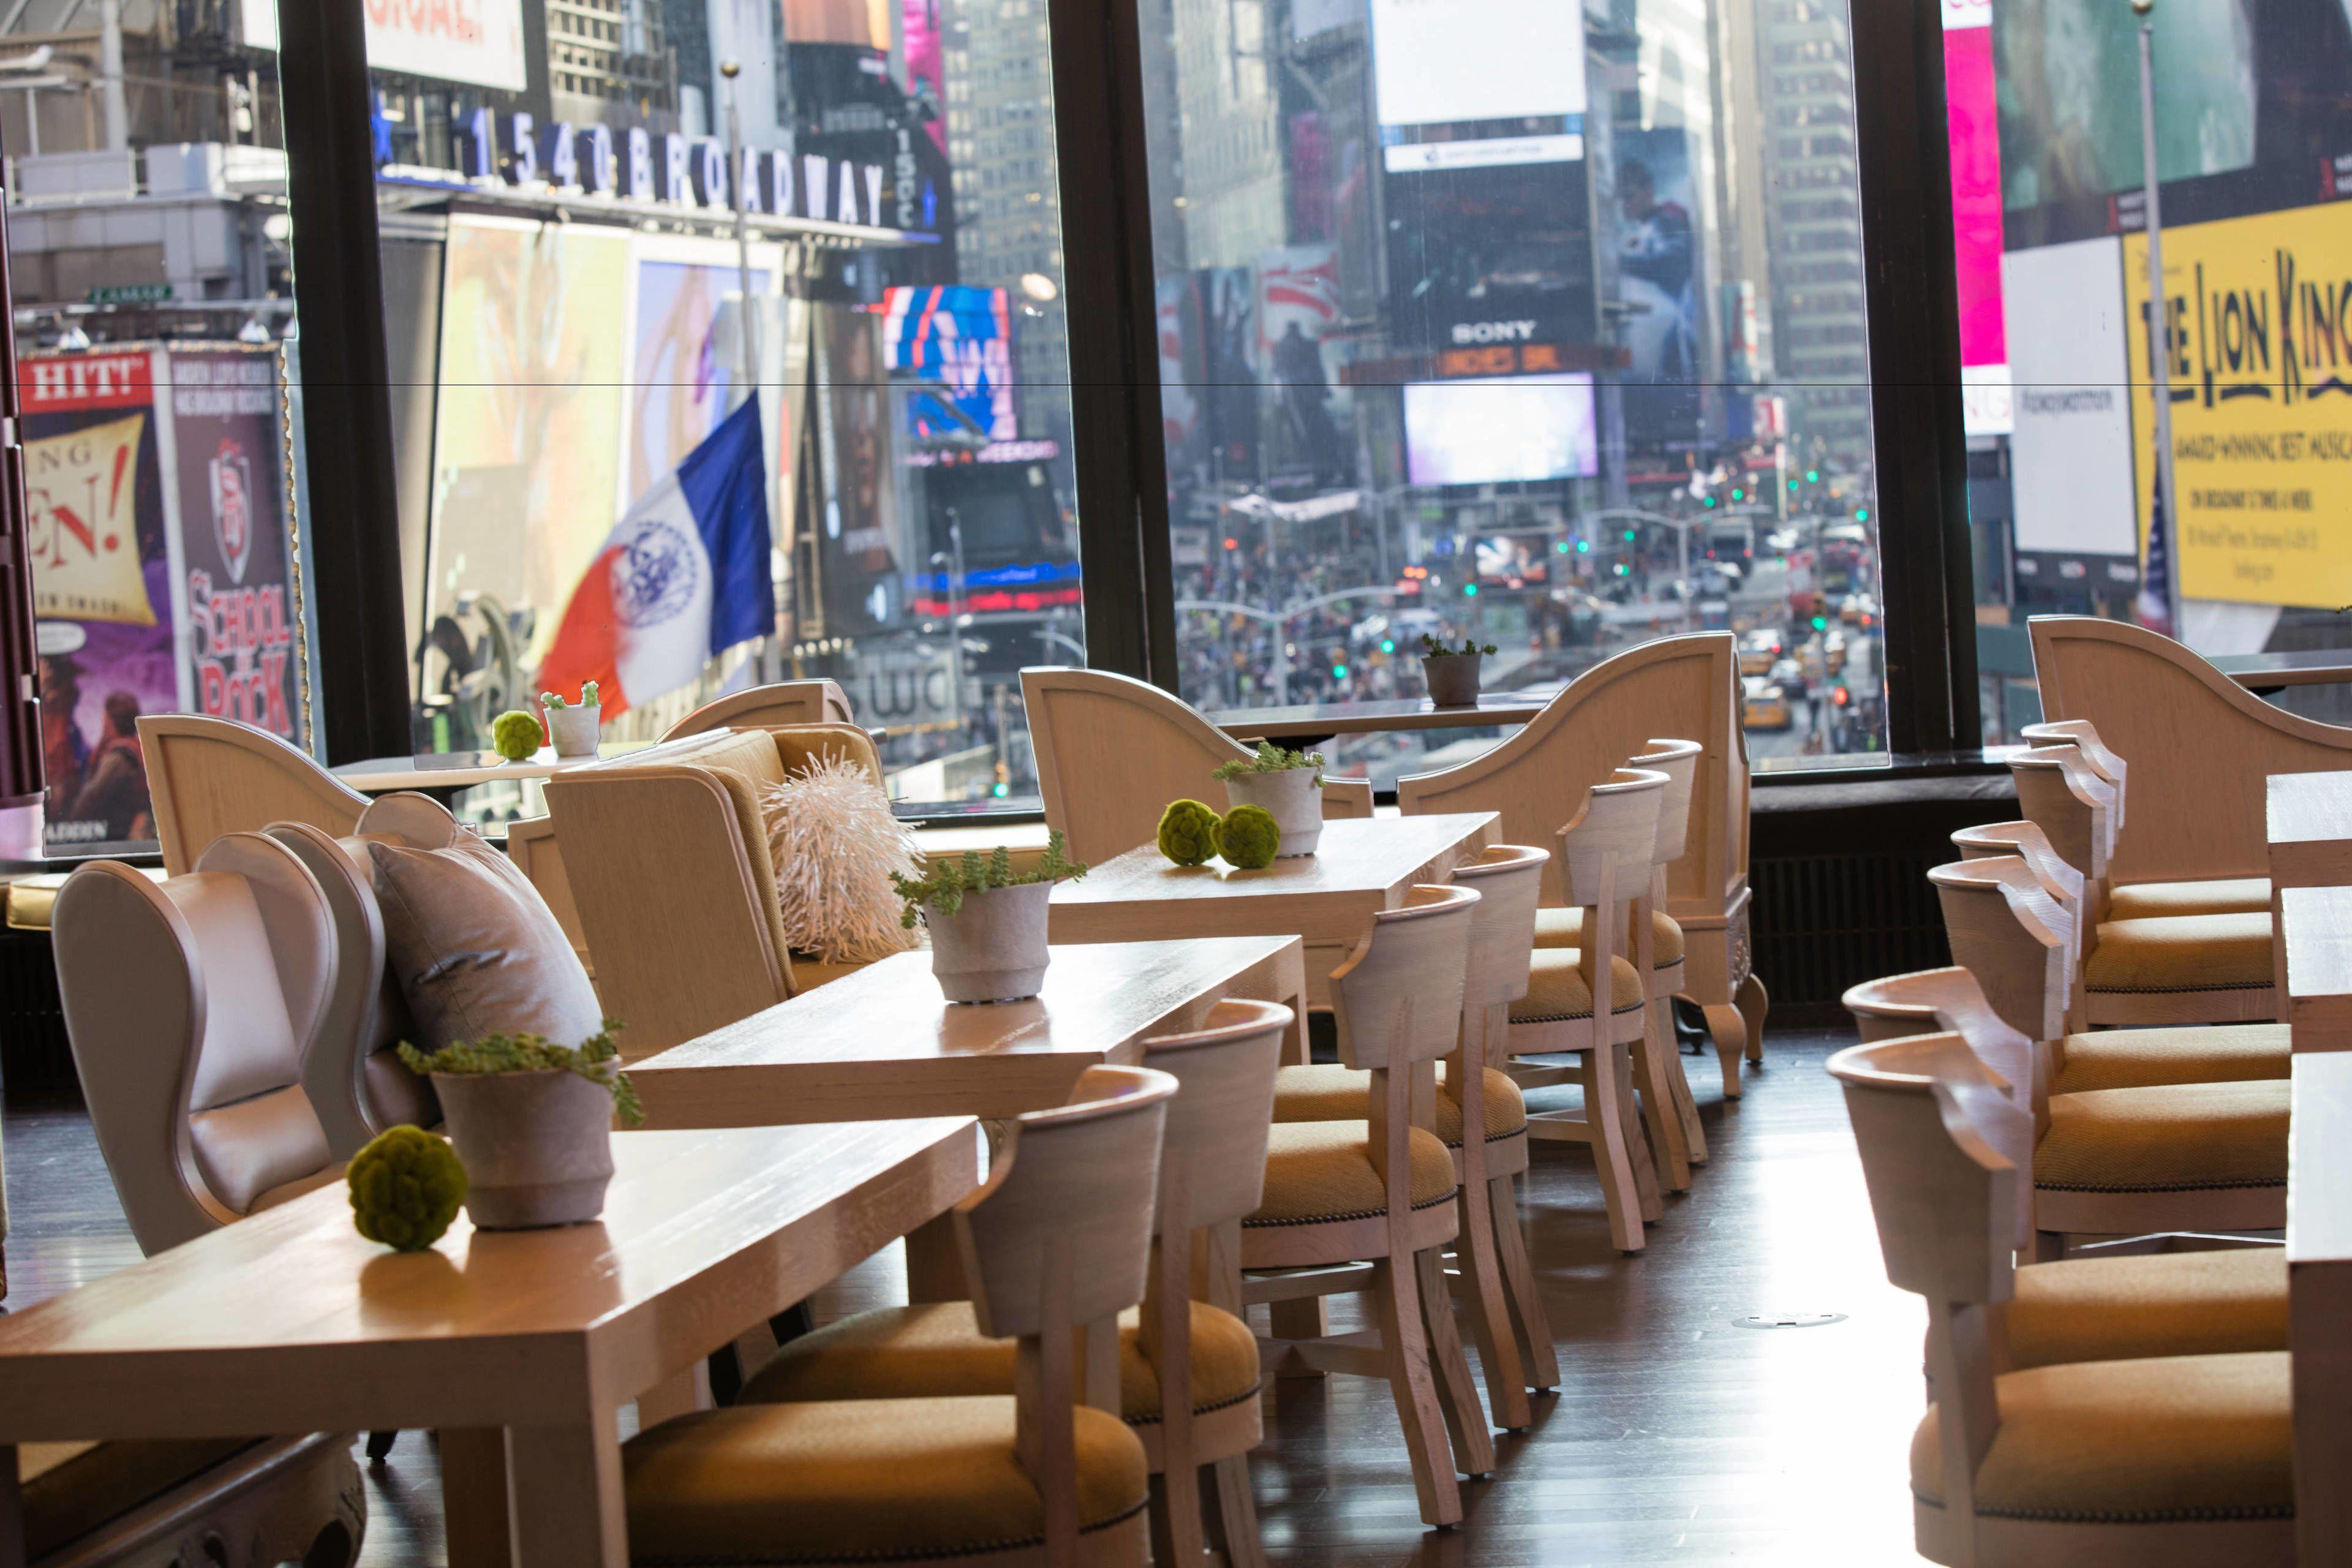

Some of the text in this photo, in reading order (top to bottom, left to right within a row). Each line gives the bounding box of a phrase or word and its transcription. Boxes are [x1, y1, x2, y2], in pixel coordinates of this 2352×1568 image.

[471, 106, 883, 228] 1540 BROADWAY
[1452, 319, 1537, 344] SONY
[2195, 260, 2271, 408] LION
[32, 360, 132, 401] HIT!
[25, 440, 93, 475] NG
[188, 568, 292, 660] SCHOOL
[198, 649, 295, 738] ROCK
